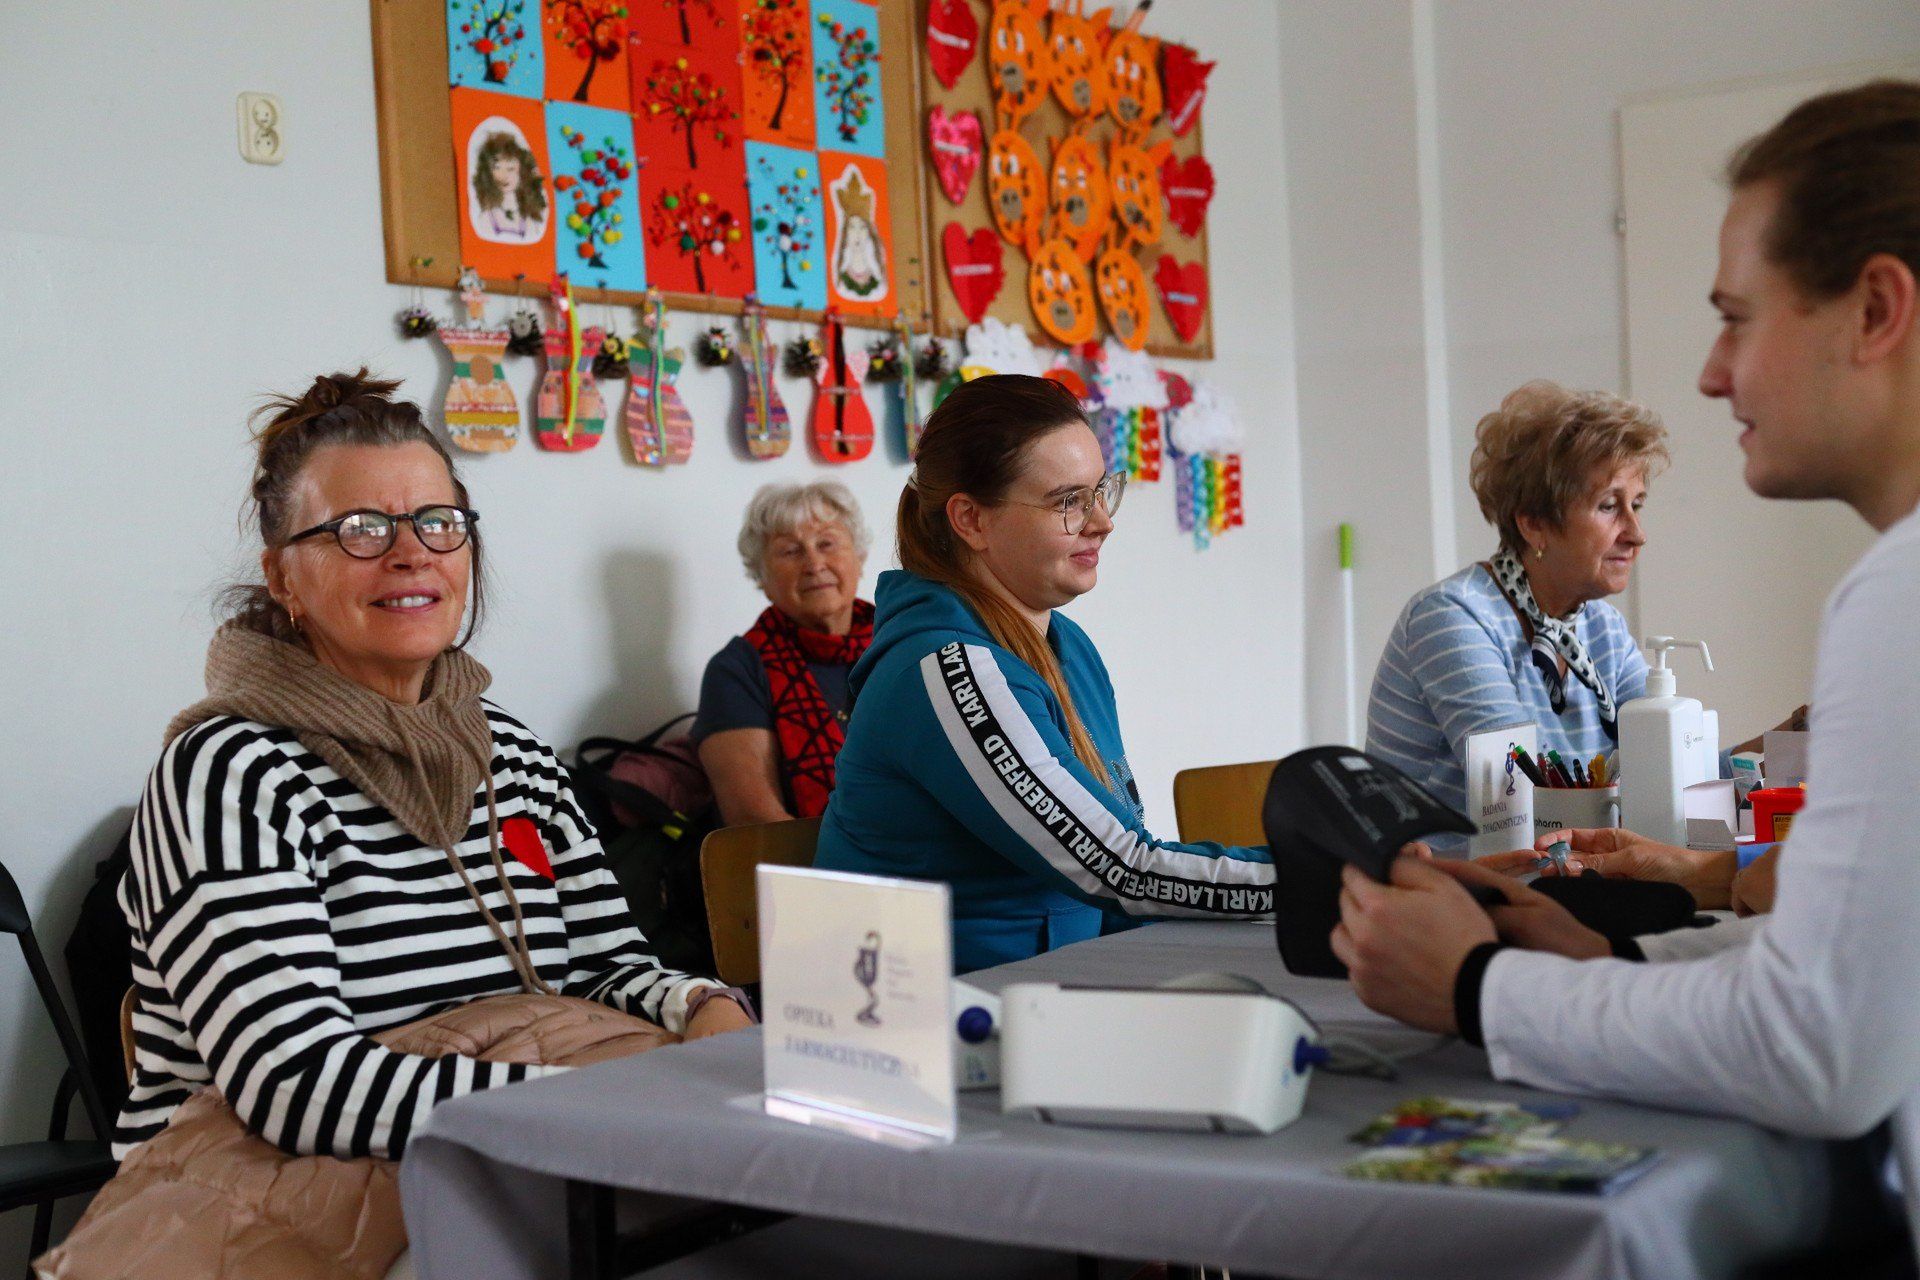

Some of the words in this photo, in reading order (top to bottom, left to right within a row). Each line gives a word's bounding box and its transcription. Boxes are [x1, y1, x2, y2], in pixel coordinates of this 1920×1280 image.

[952, 676, 988, 728] KARL
[983, 734, 1075, 838] LAGERFELD
[1068, 827, 1114, 874] KARL
[1106, 865, 1215, 909] LAGERFELD
[1218, 889, 1274, 911] KARL
